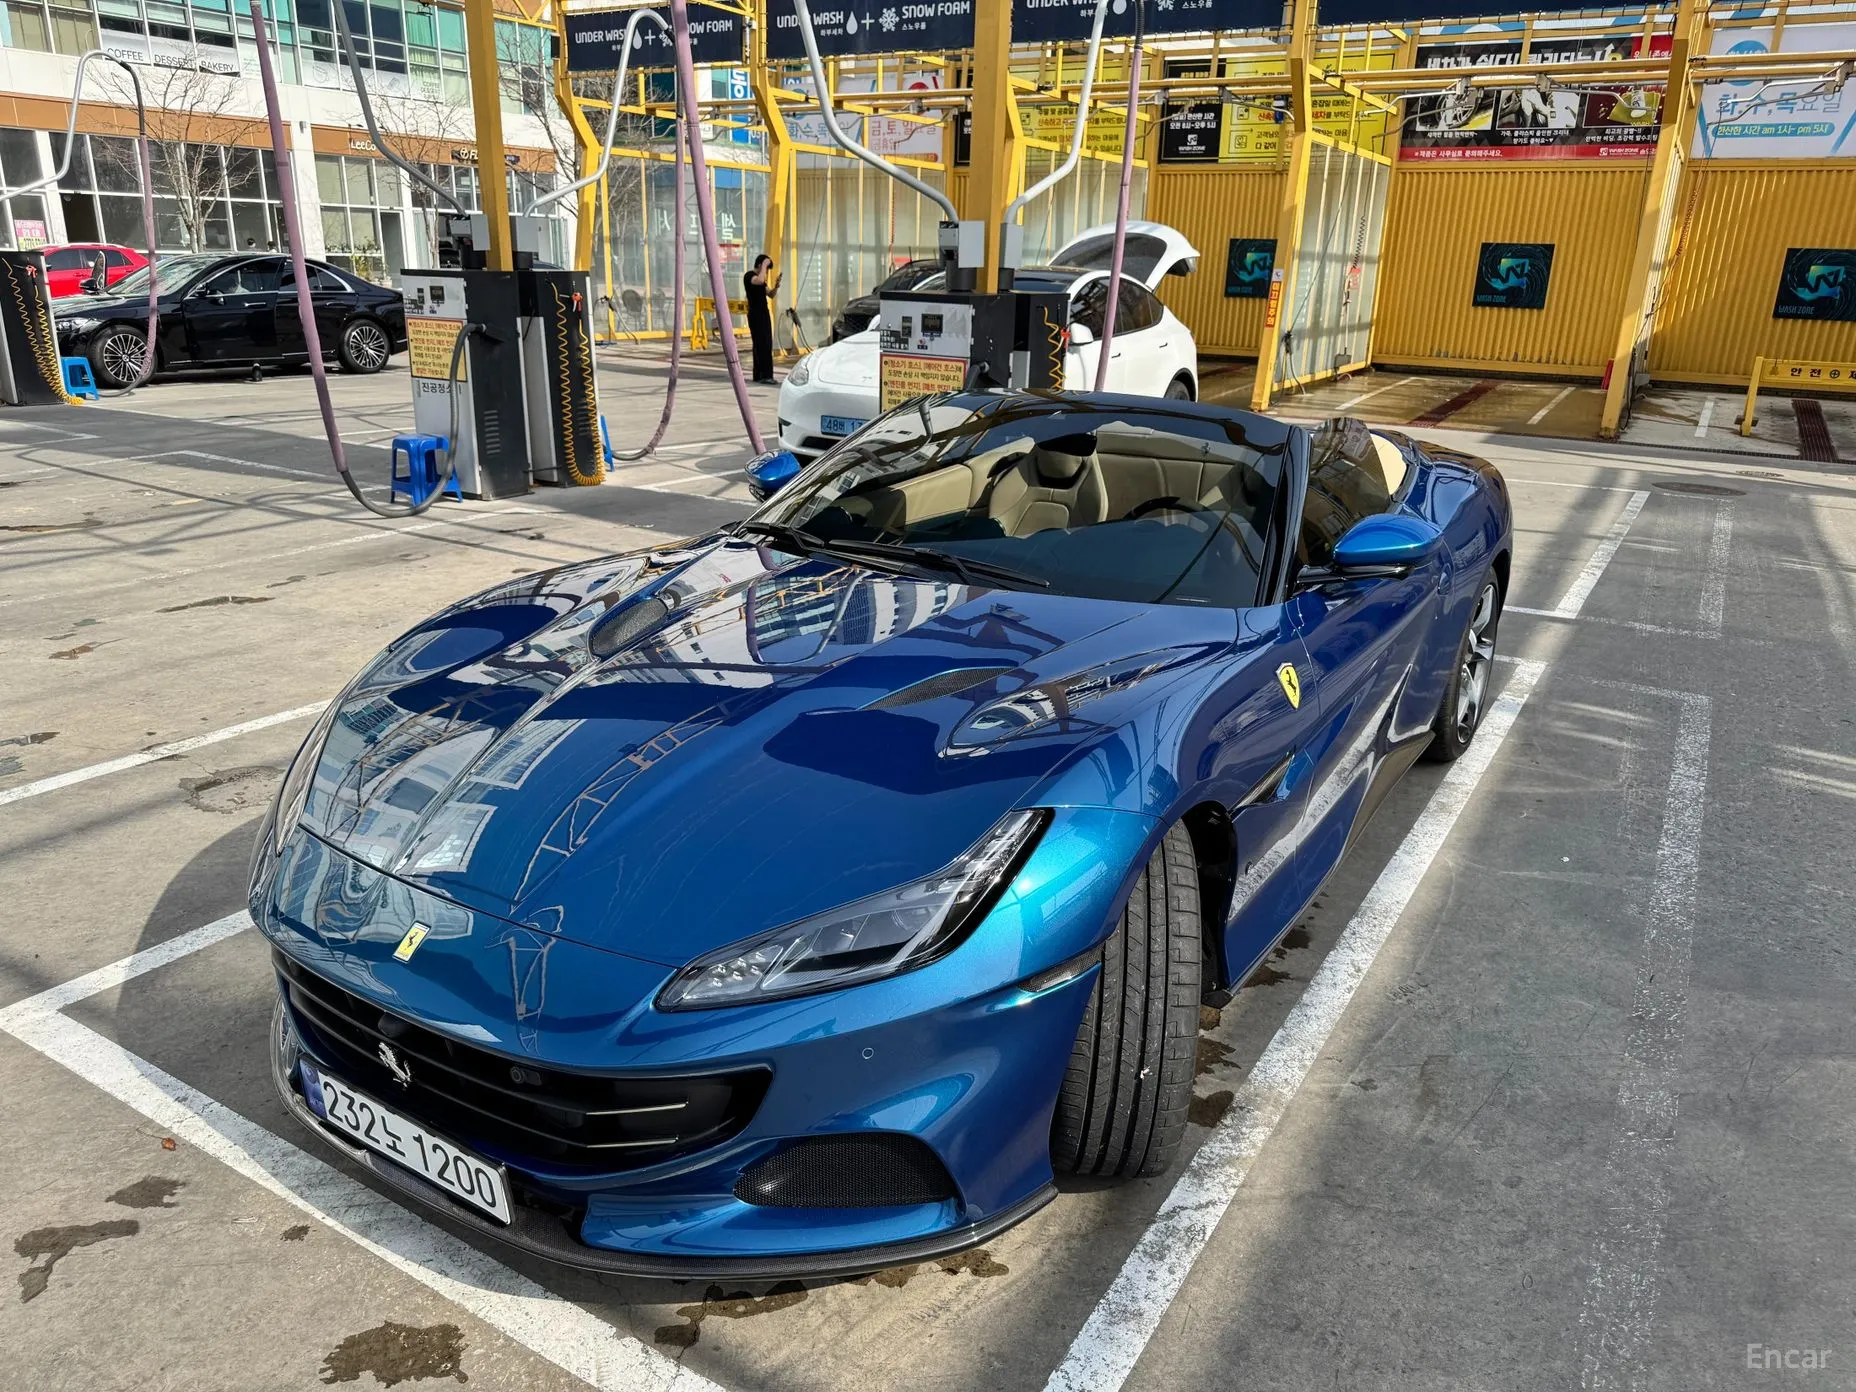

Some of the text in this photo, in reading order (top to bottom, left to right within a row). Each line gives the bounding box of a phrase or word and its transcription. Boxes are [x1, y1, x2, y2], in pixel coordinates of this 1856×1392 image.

[902, 1, 970, 19] SNOW FOAM
[706, 19, 733, 33] FOAM
[777, 11, 844, 28] UND WASH
[575, 29, 604, 44] UNDER
[107, 48, 144, 61] COFFEE
[154, 54, 194, 68] DESSERT
[201, 61, 234, 72] BAKERY
[1717, 126, 1743, 136] 한산한
[1743, 125, 1761, 135] 시간
[1762, 127, 1775, 135] am
[1797, 126, 1811, 136] pm
[1813, 124, 1828, 133] 5시
[1778, 304, 1815, 315] WASH ZONE
[903, 370, 914, 379] 손상
[914, 371, 919, 379] 시
[323, 1080, 497, 1208] 232노 1200
